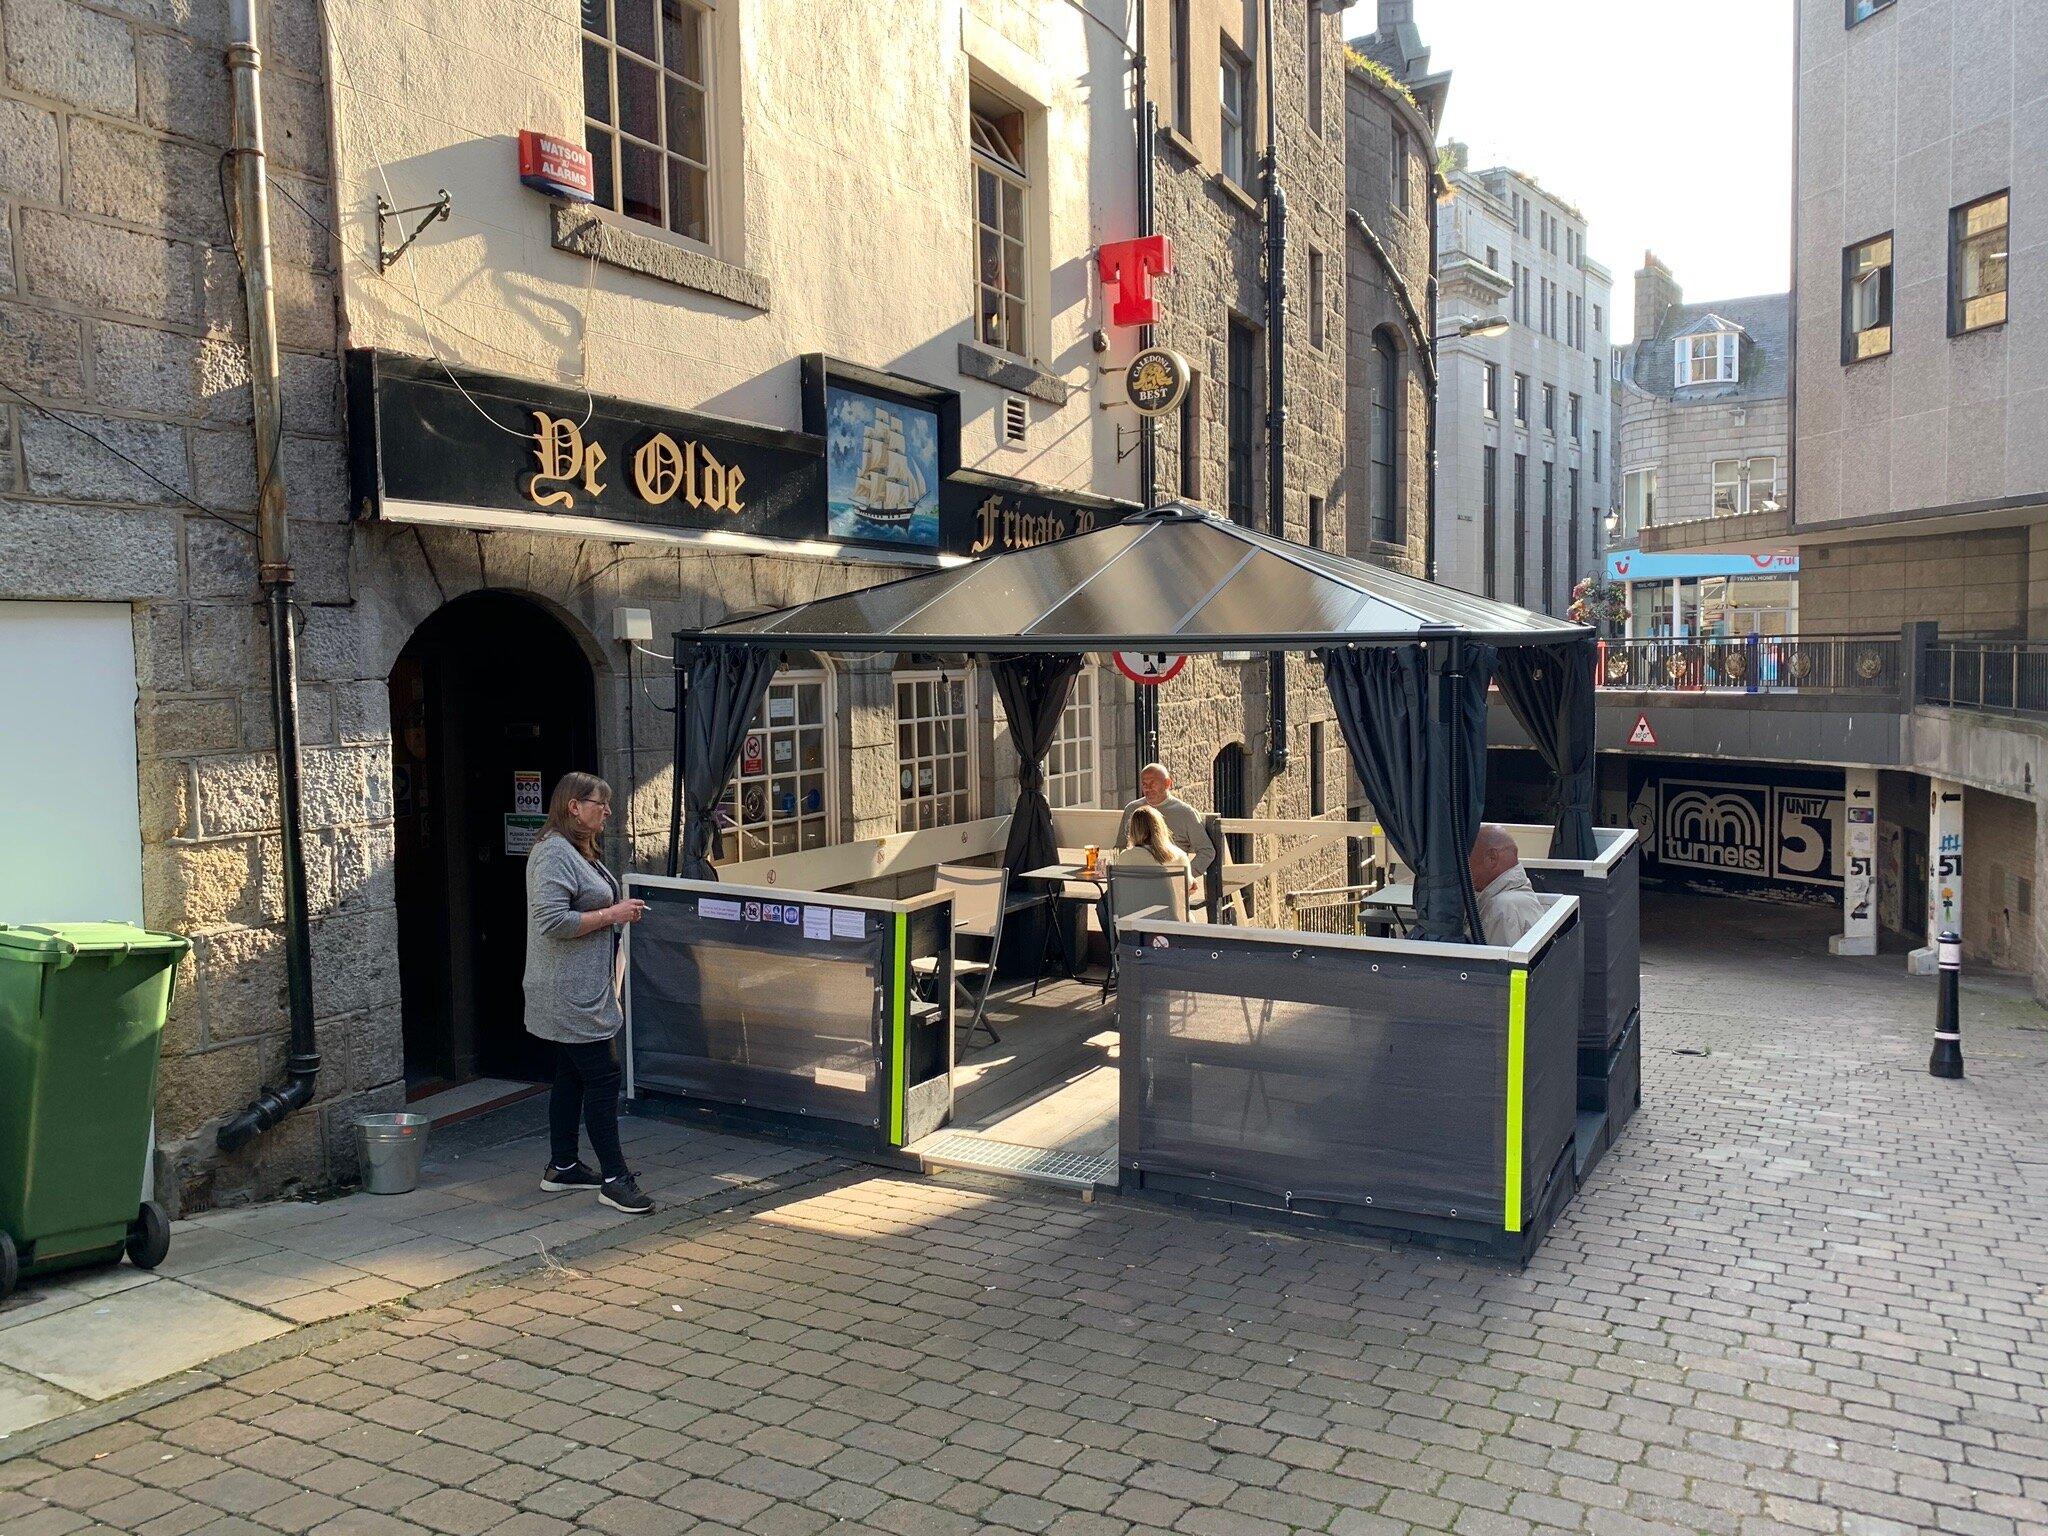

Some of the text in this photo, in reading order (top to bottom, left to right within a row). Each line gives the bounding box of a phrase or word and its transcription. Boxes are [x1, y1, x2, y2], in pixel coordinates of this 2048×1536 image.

[540, 139, 586, 166] WATSON
[542, 161, 588, 187] ALARMS
[1133, 355, 1171, 377] CALEDONIA
[1139, 388, 1167, 401] BEST
[531, 411, 607, 509] Ye
[634, 432, 746, 514] Olde
[1786, 797, 1823, 816] UNIT
[1850, 858, 1871, 876] 51
[1938, 855, 1962, 877] 51
